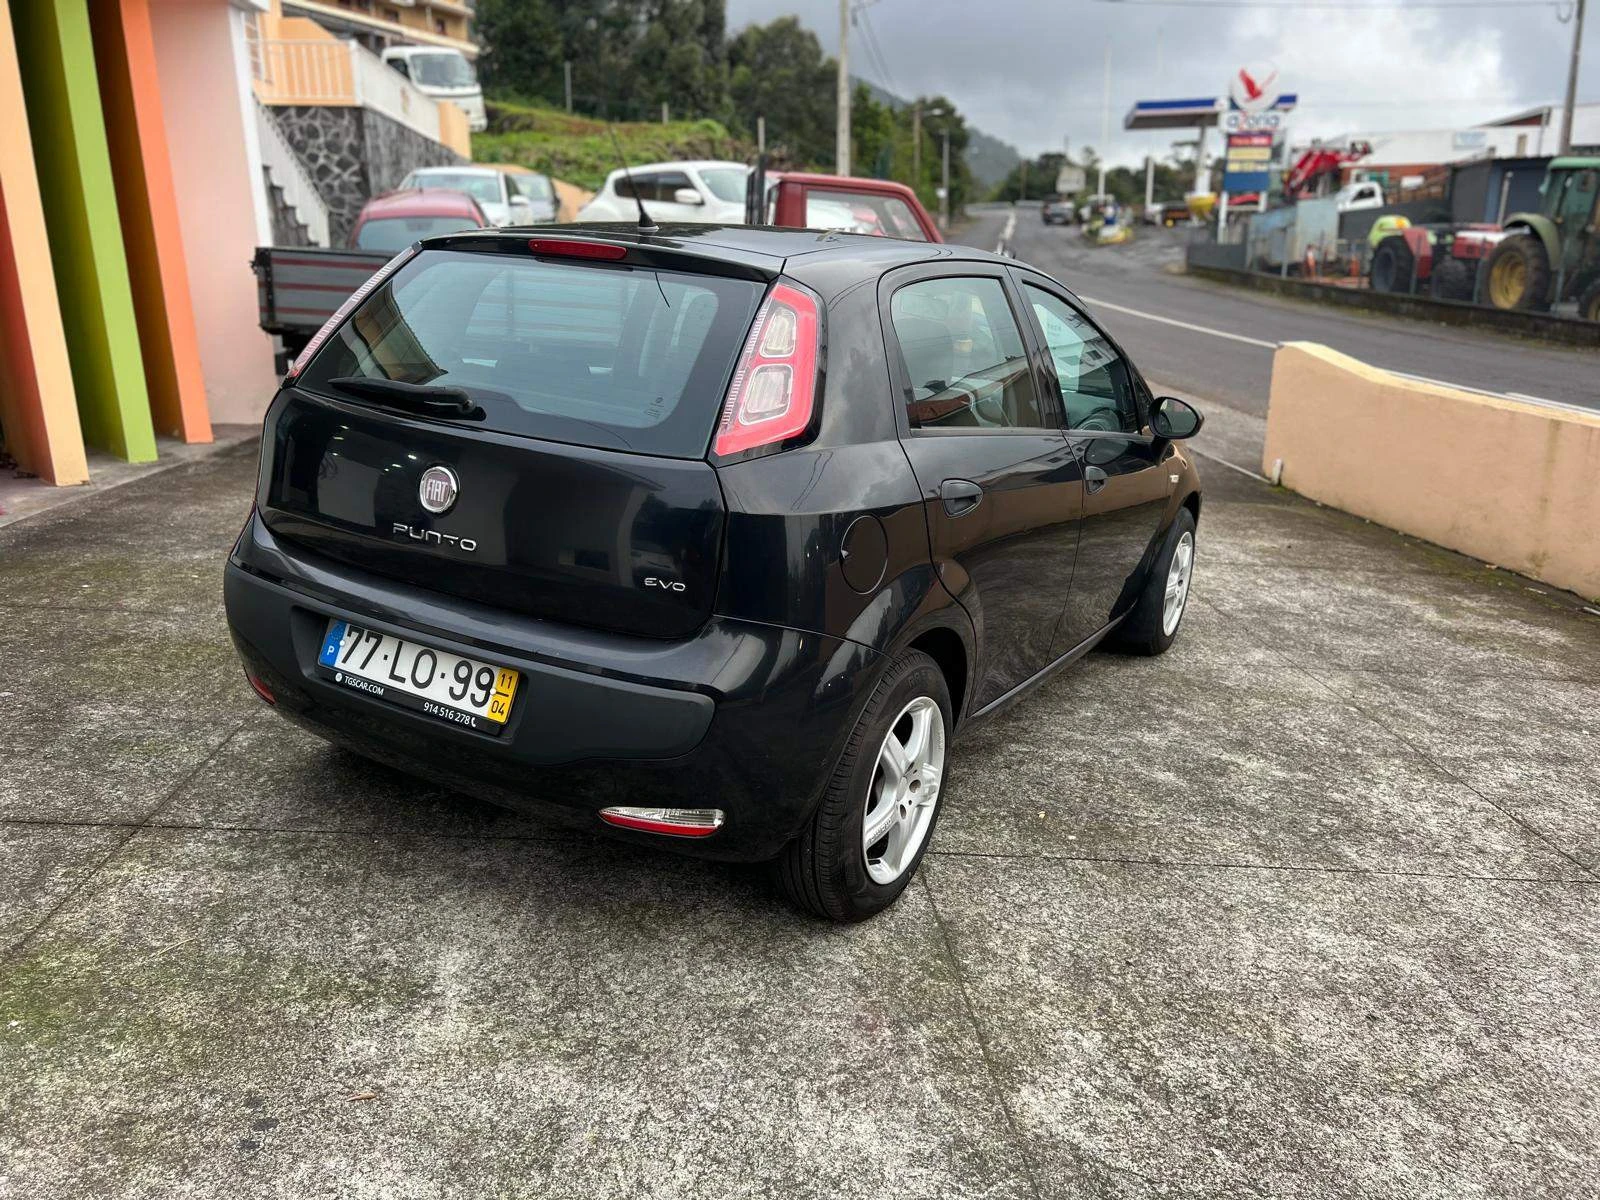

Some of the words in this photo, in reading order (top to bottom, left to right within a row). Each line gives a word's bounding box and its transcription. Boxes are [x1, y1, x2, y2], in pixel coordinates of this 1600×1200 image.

[426, 478, 449, 502] FIAT
[393, 522, 478, 551] PUNTO
[644, 577, 686, 592] EVO
[326, 645, 335, 656] P
[344, 675, 385, 696] TGSCAR.COM
[500, 672, 513, 690] 11
[424, 702, 439, 714] 914
[439, 707, 455, 720] 516
[454, 712, 471, 725] 278
[491, 700, 505, 717] 04
